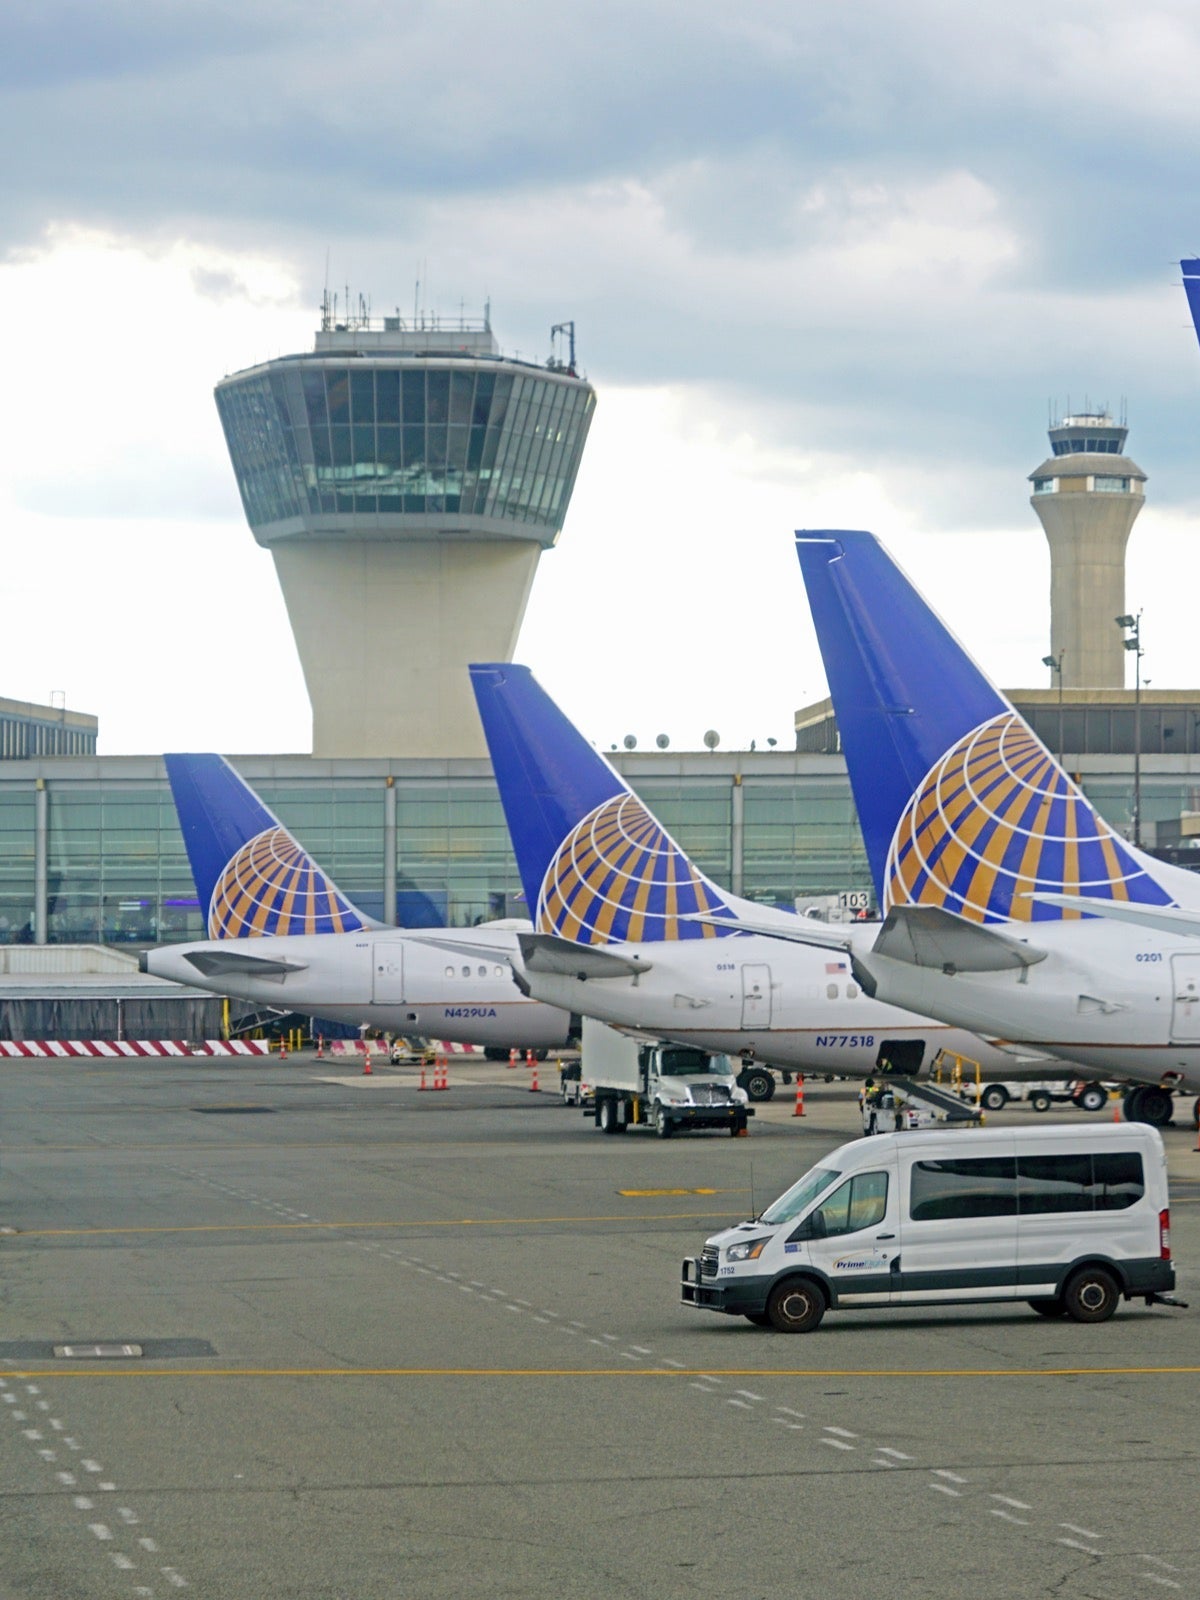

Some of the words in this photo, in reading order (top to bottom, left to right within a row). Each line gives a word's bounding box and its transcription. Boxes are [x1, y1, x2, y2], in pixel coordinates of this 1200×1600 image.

[841, 893, 868, 907] 103
[1135, 952, 1163, 962] 0201
[444, 1008, 497, 1018] N429UA
[815, 1035, 875, 1047] N77518
[720, 1267, 735, 1275] 1752
